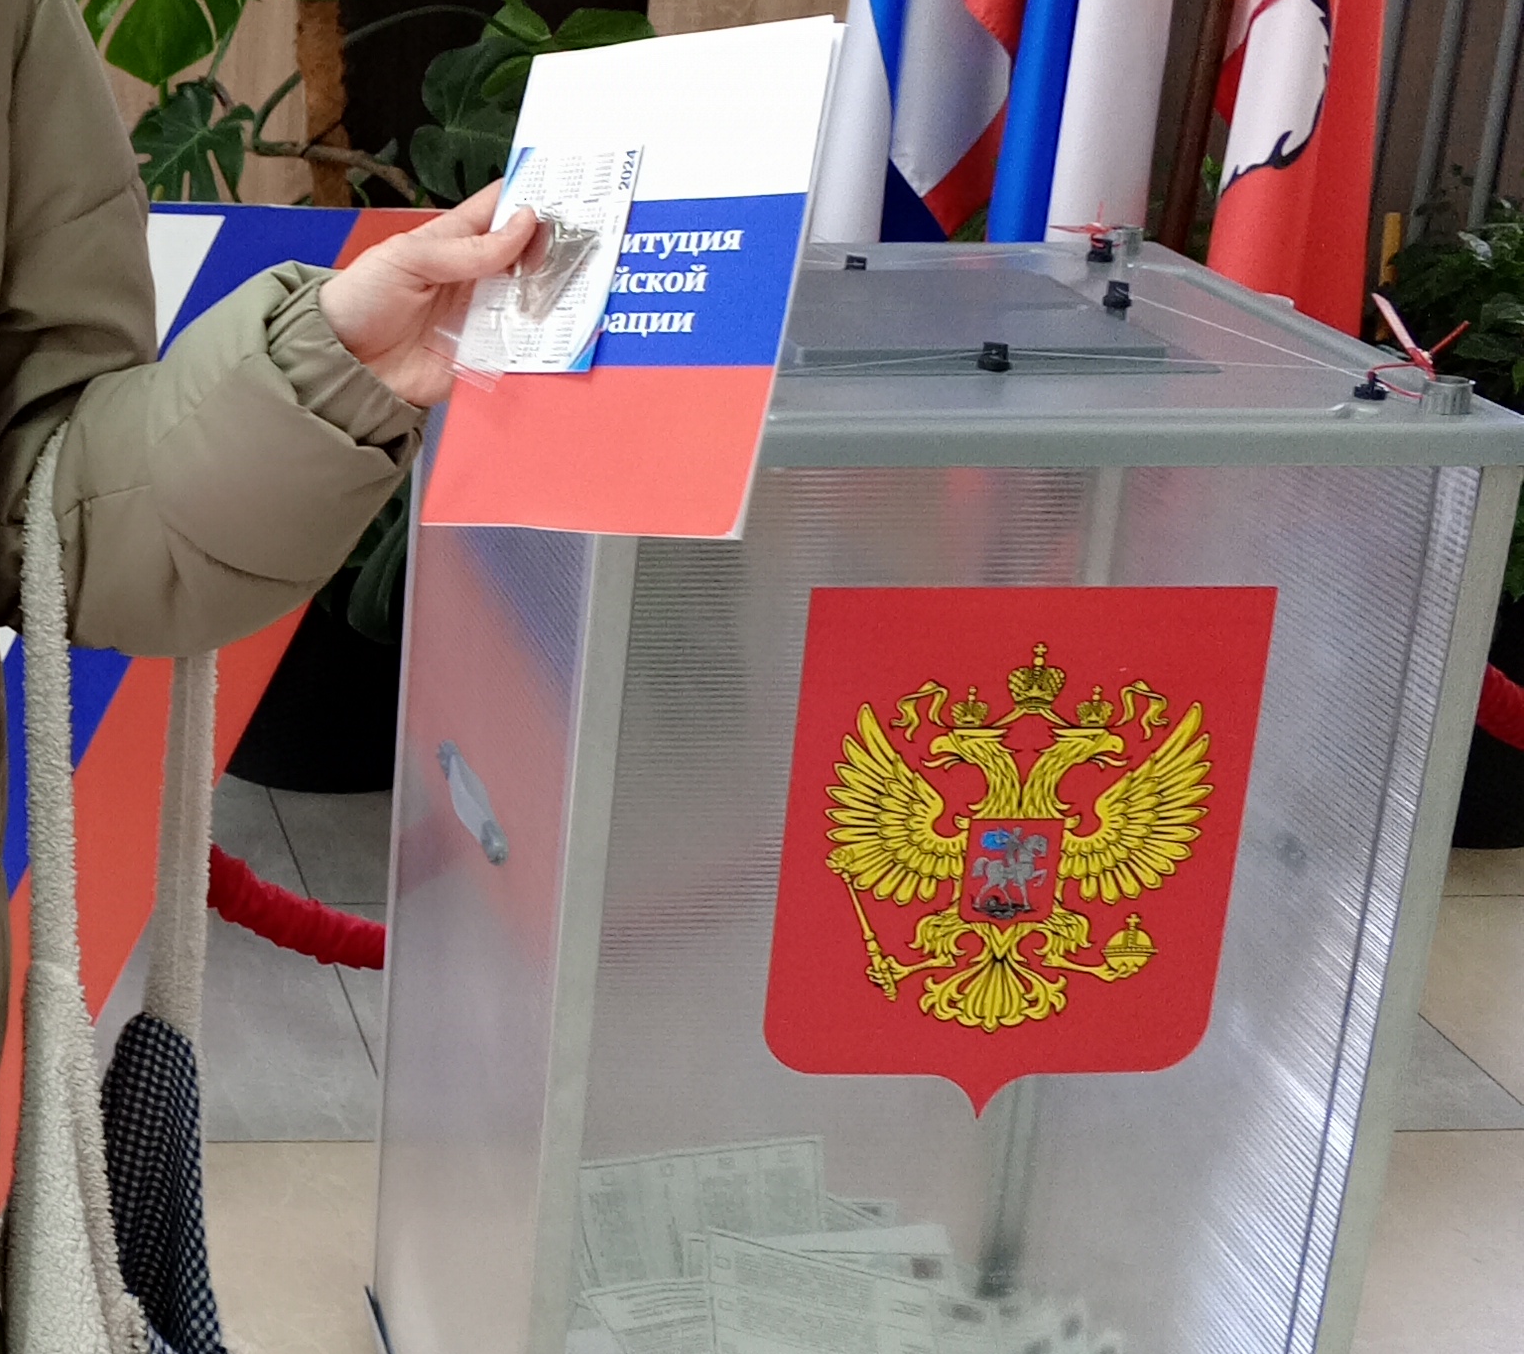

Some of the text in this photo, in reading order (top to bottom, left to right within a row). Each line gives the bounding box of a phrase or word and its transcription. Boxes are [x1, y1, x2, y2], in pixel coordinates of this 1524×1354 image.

[617, 150, 639, 191] 2024
[620, 229, 746, 260] итуция
[609, 263, 710, 294] йской
